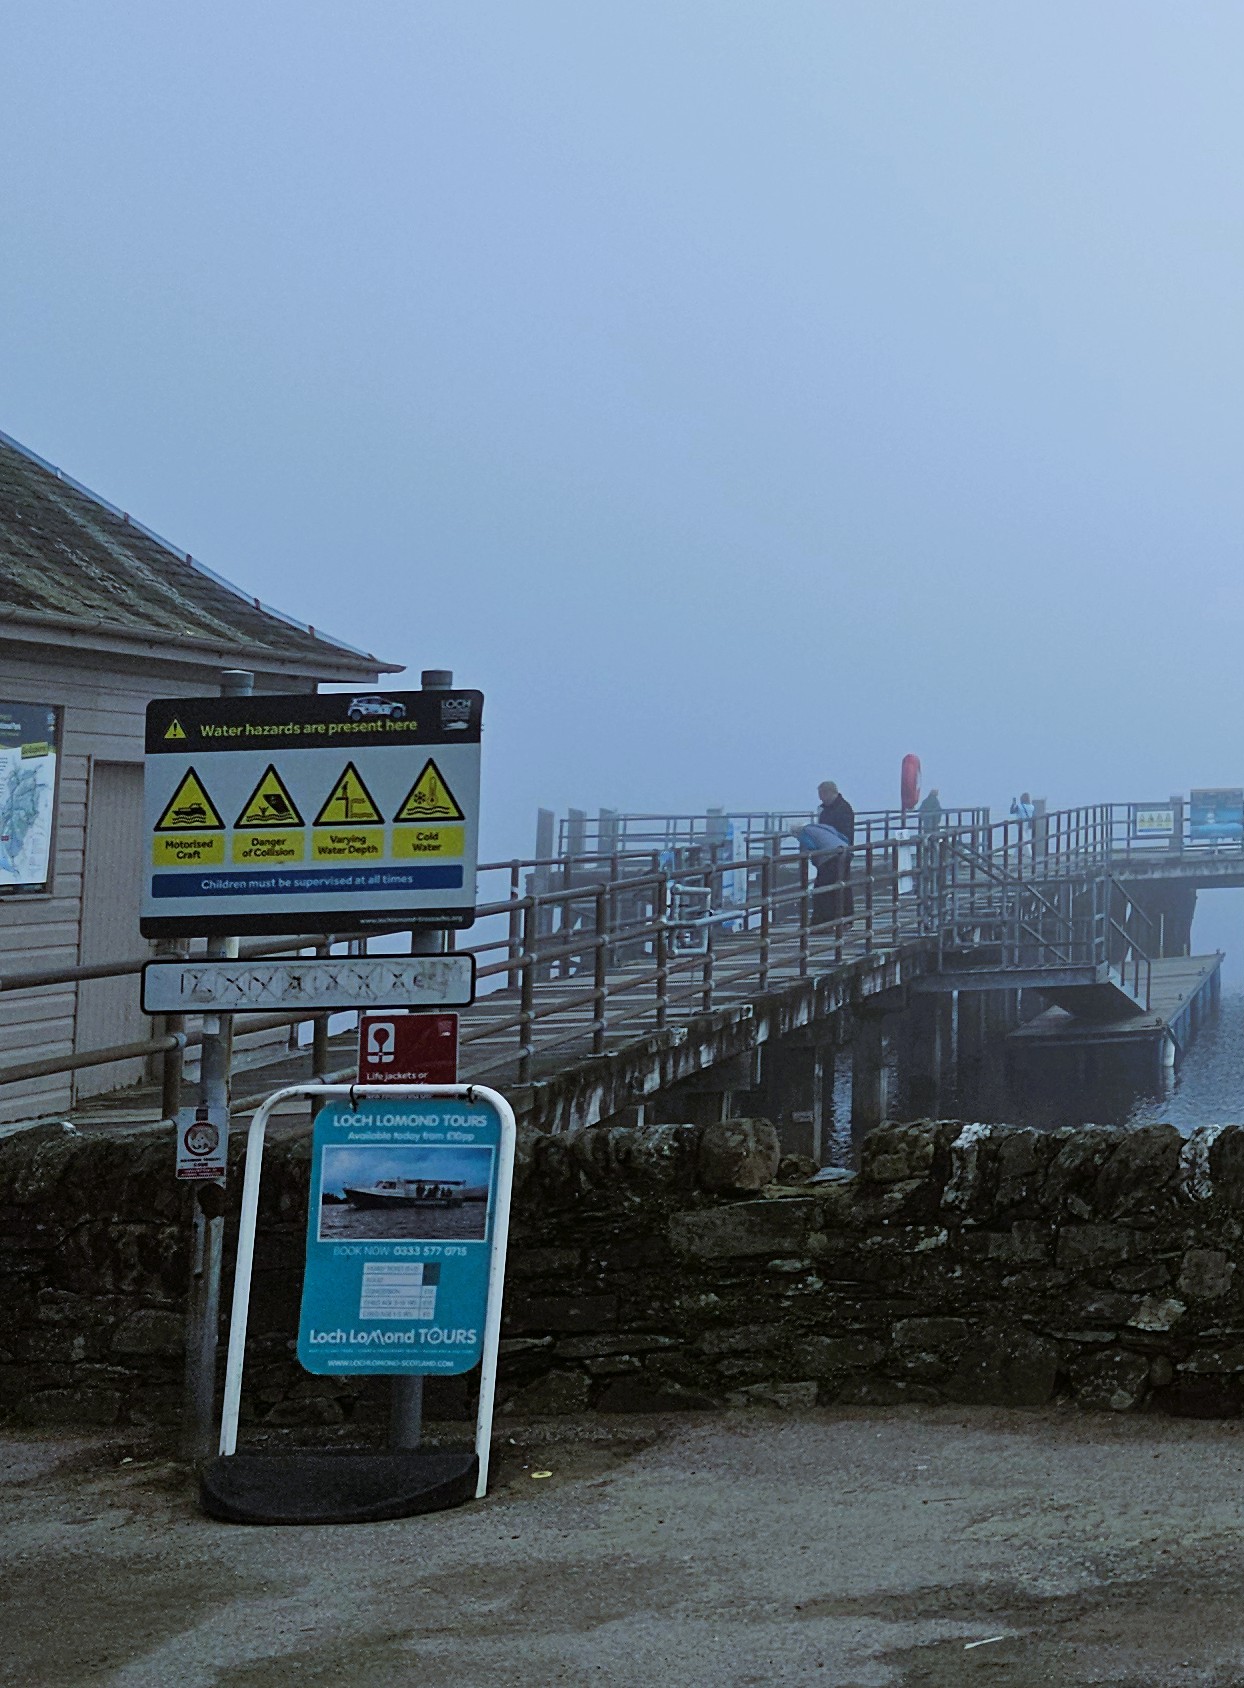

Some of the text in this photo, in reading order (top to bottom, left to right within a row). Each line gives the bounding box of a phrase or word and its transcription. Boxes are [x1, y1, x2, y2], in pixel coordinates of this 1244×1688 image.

[200, 719, 418, 737] Water hazards are present here
[330, 835, 367, 846] Varying
[416, 832, 439, 841] Cold
[165, 839, 214, 850] Motorised
[251, 838, 287, 849] Danger
[412, 843, 442, 852] Water
[176, 850, 201, 860] Craft
[242, 848, 295, 857] of Collision
[318, 845, 379, 856] Water Depth
[201, 873, 413, 889] Children must be supervised at all times
[366, 1072, 383, 1080] Life
[383, 1071, 417, 1082] jackets
[333, 1114, 488, 1127] LOCH LOMOND TOURS
[347, 1131, 392, 1141] Available
[393, 1131, 421, 1142] today
[423, 1131, 444, 1140] from
[333, 1246, 361, 1256] BOOK
[393, 1246, 420, 1256] 0333
[423, 1246, 442, 1256] 577
[309, 1328, 347, 1344] Loch
[418, 1325, 477, 1344] TOURS
